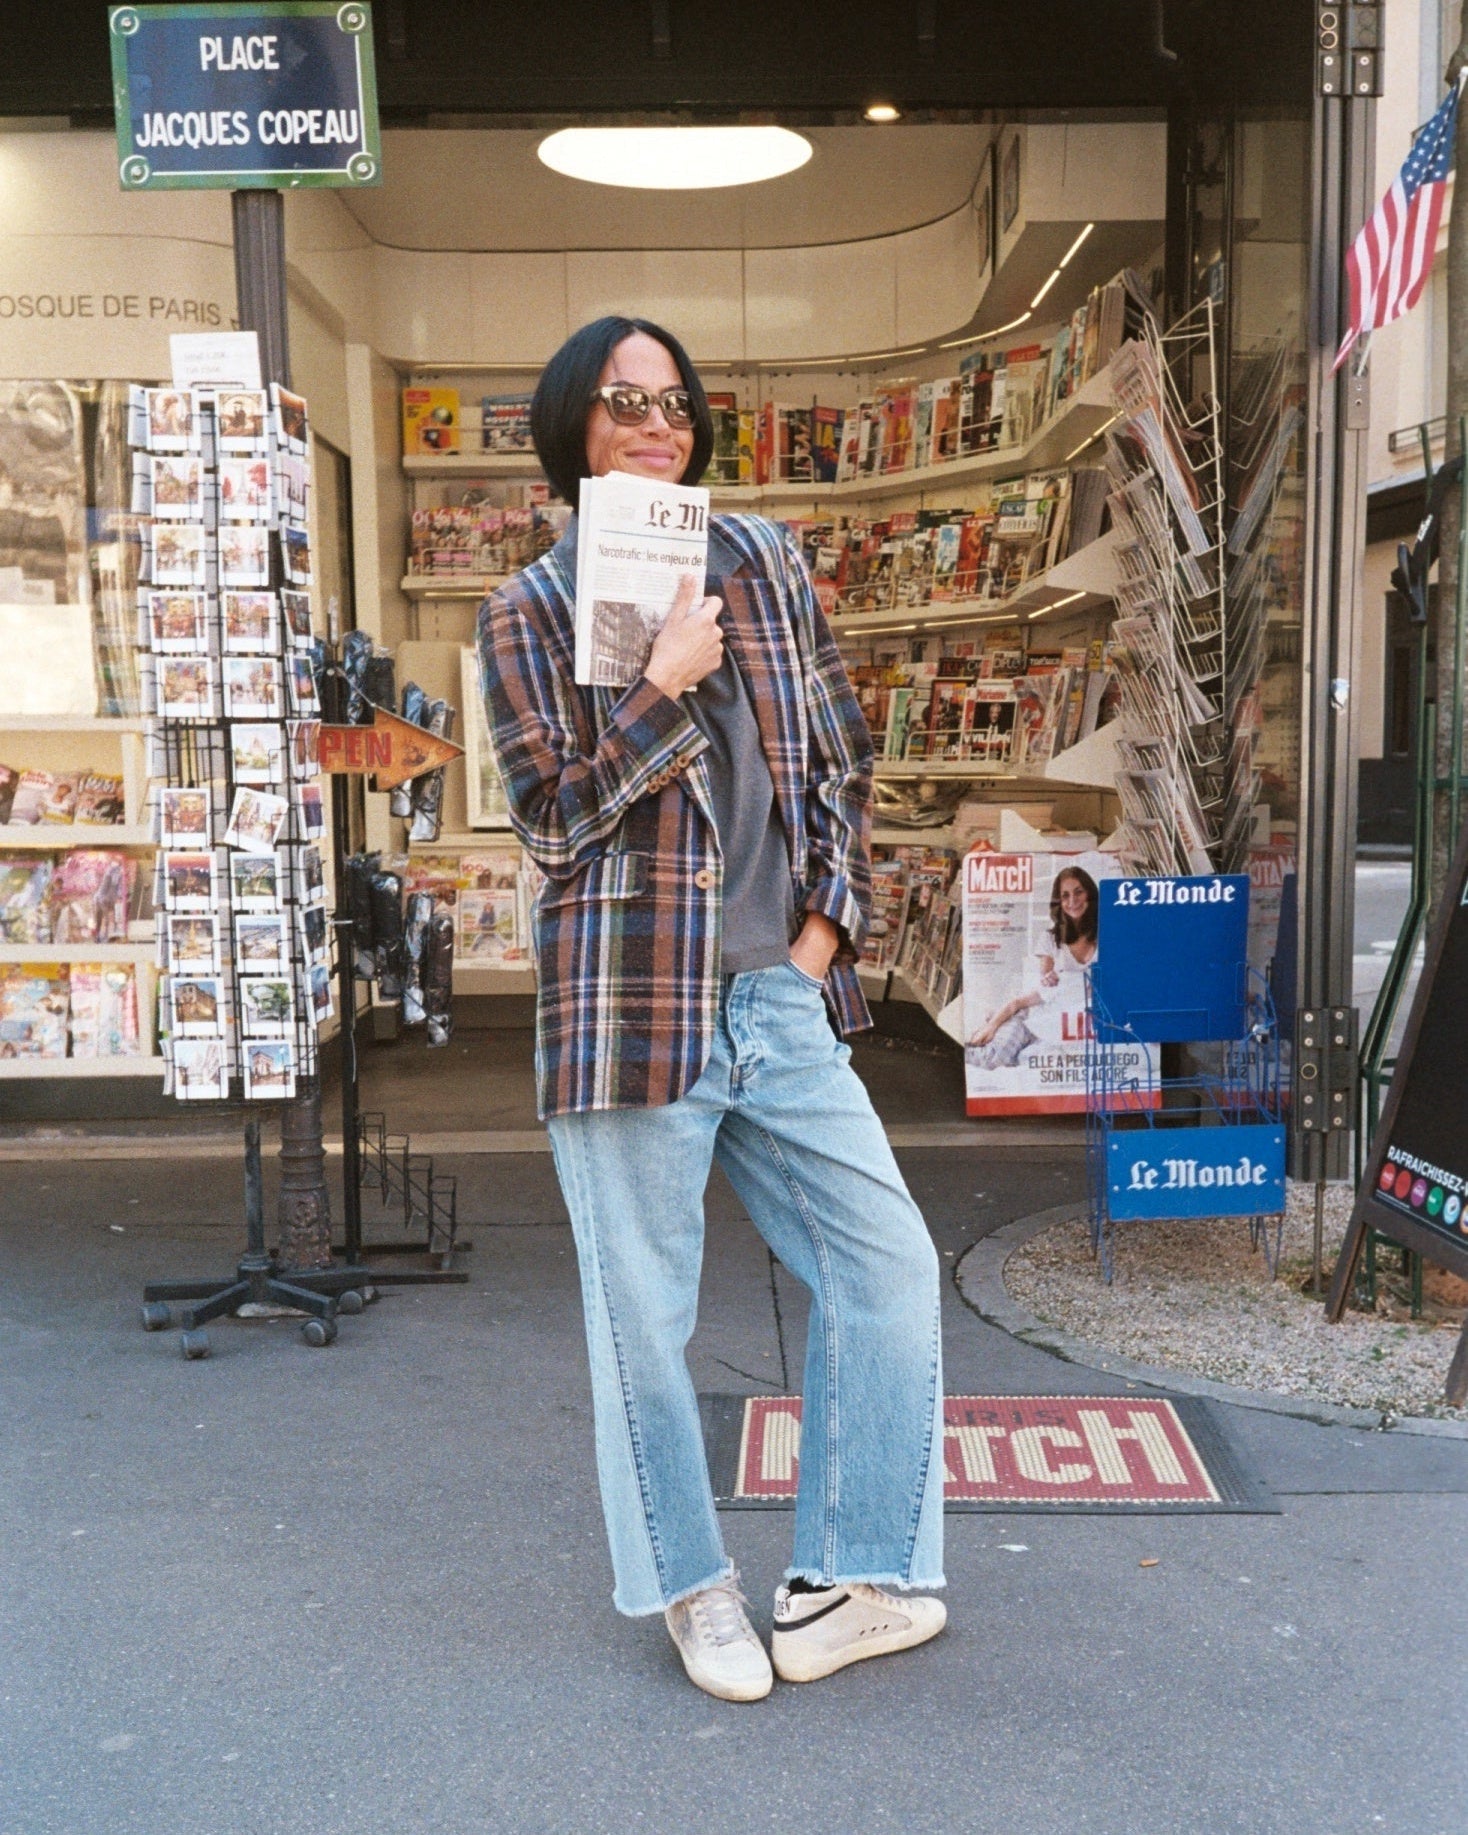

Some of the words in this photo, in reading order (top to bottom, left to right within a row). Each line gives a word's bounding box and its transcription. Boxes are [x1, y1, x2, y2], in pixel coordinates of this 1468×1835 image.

[200, 36, 280, 71] PLACE
[136, 111, 250, 149] JACQUES
[257, 109, 359, 145] COPEAU
[102, 295, 140, 318] DE
[149, 297, 221, 326] PARIS
[644, 500, 671, 528] Le
[647, 549, 658, 561] les
[660, 553, 689, 567] enjeux
[691, 555, 702, 567] de
[969, 857, 1031, 891] MATCH
[1113, 881, 1142, 906] Le
[1143, 879, 1236, 904] Monde
[1029, 1056, 1053, 1069] ELLE
[1056, 1055, 1064, 1068] A
[1040, 1069, 1063, 1083] SON
[1066, 1068, 1089, 1082] FILS
[1127, 1160, 1158, 1190] Le
[1160, 1157, 1267, 1188] Monde
[762, 1409, 1189, 1485] TCH
